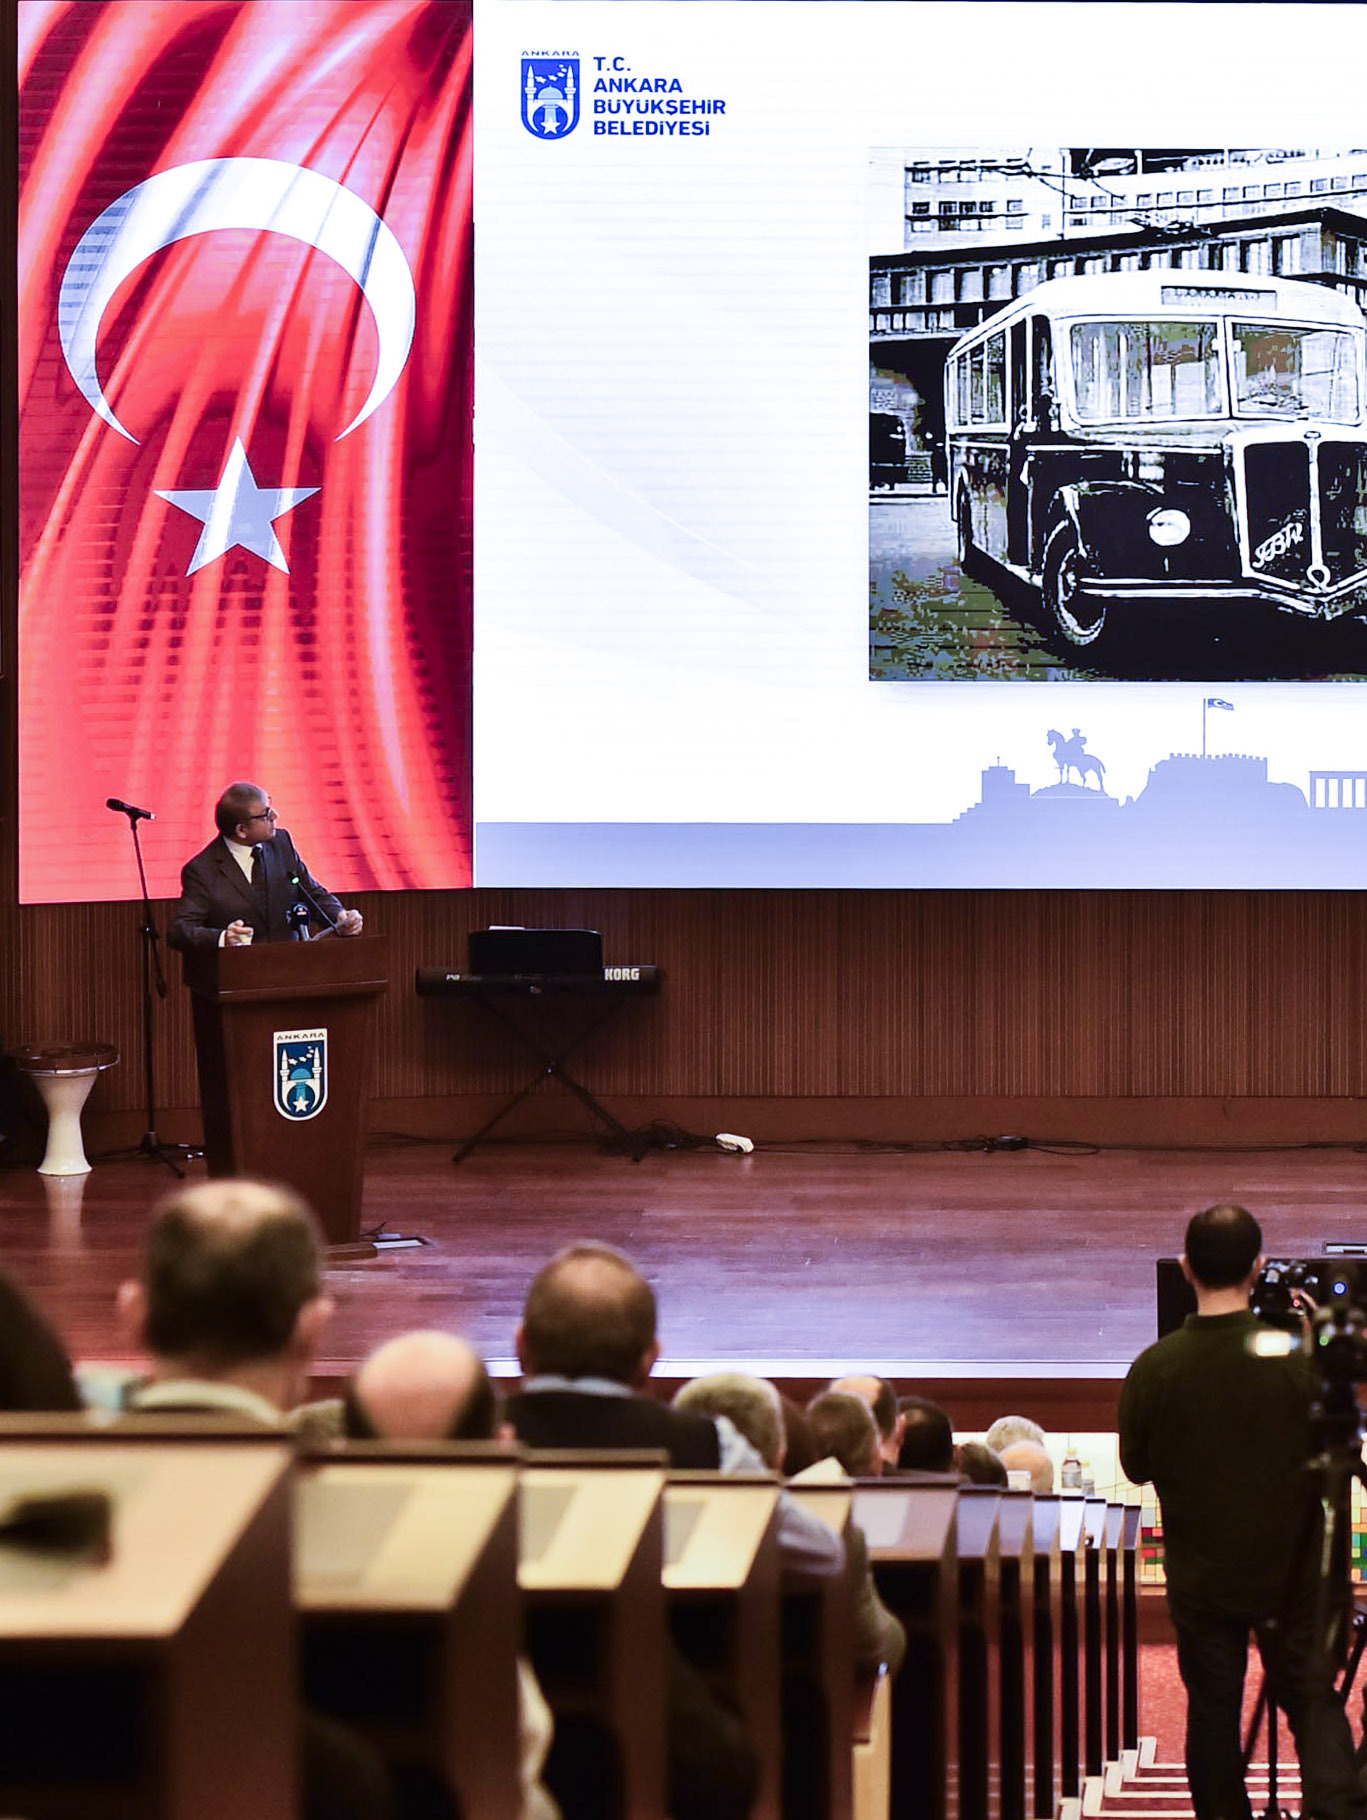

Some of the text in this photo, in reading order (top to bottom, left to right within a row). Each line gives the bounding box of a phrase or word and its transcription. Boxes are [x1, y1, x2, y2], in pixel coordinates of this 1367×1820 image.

[593, 56, 631, 72] T.C.
[593, 77, 684, 94] ANKARA
[593, 98, 727, 116] BÜYÜKŞEHİR
[593, 120, 710, 137] BELEDİYESİ
[604, 967, 640, 981] KORG
[277, 1032, 325, 1041] ANKARA
